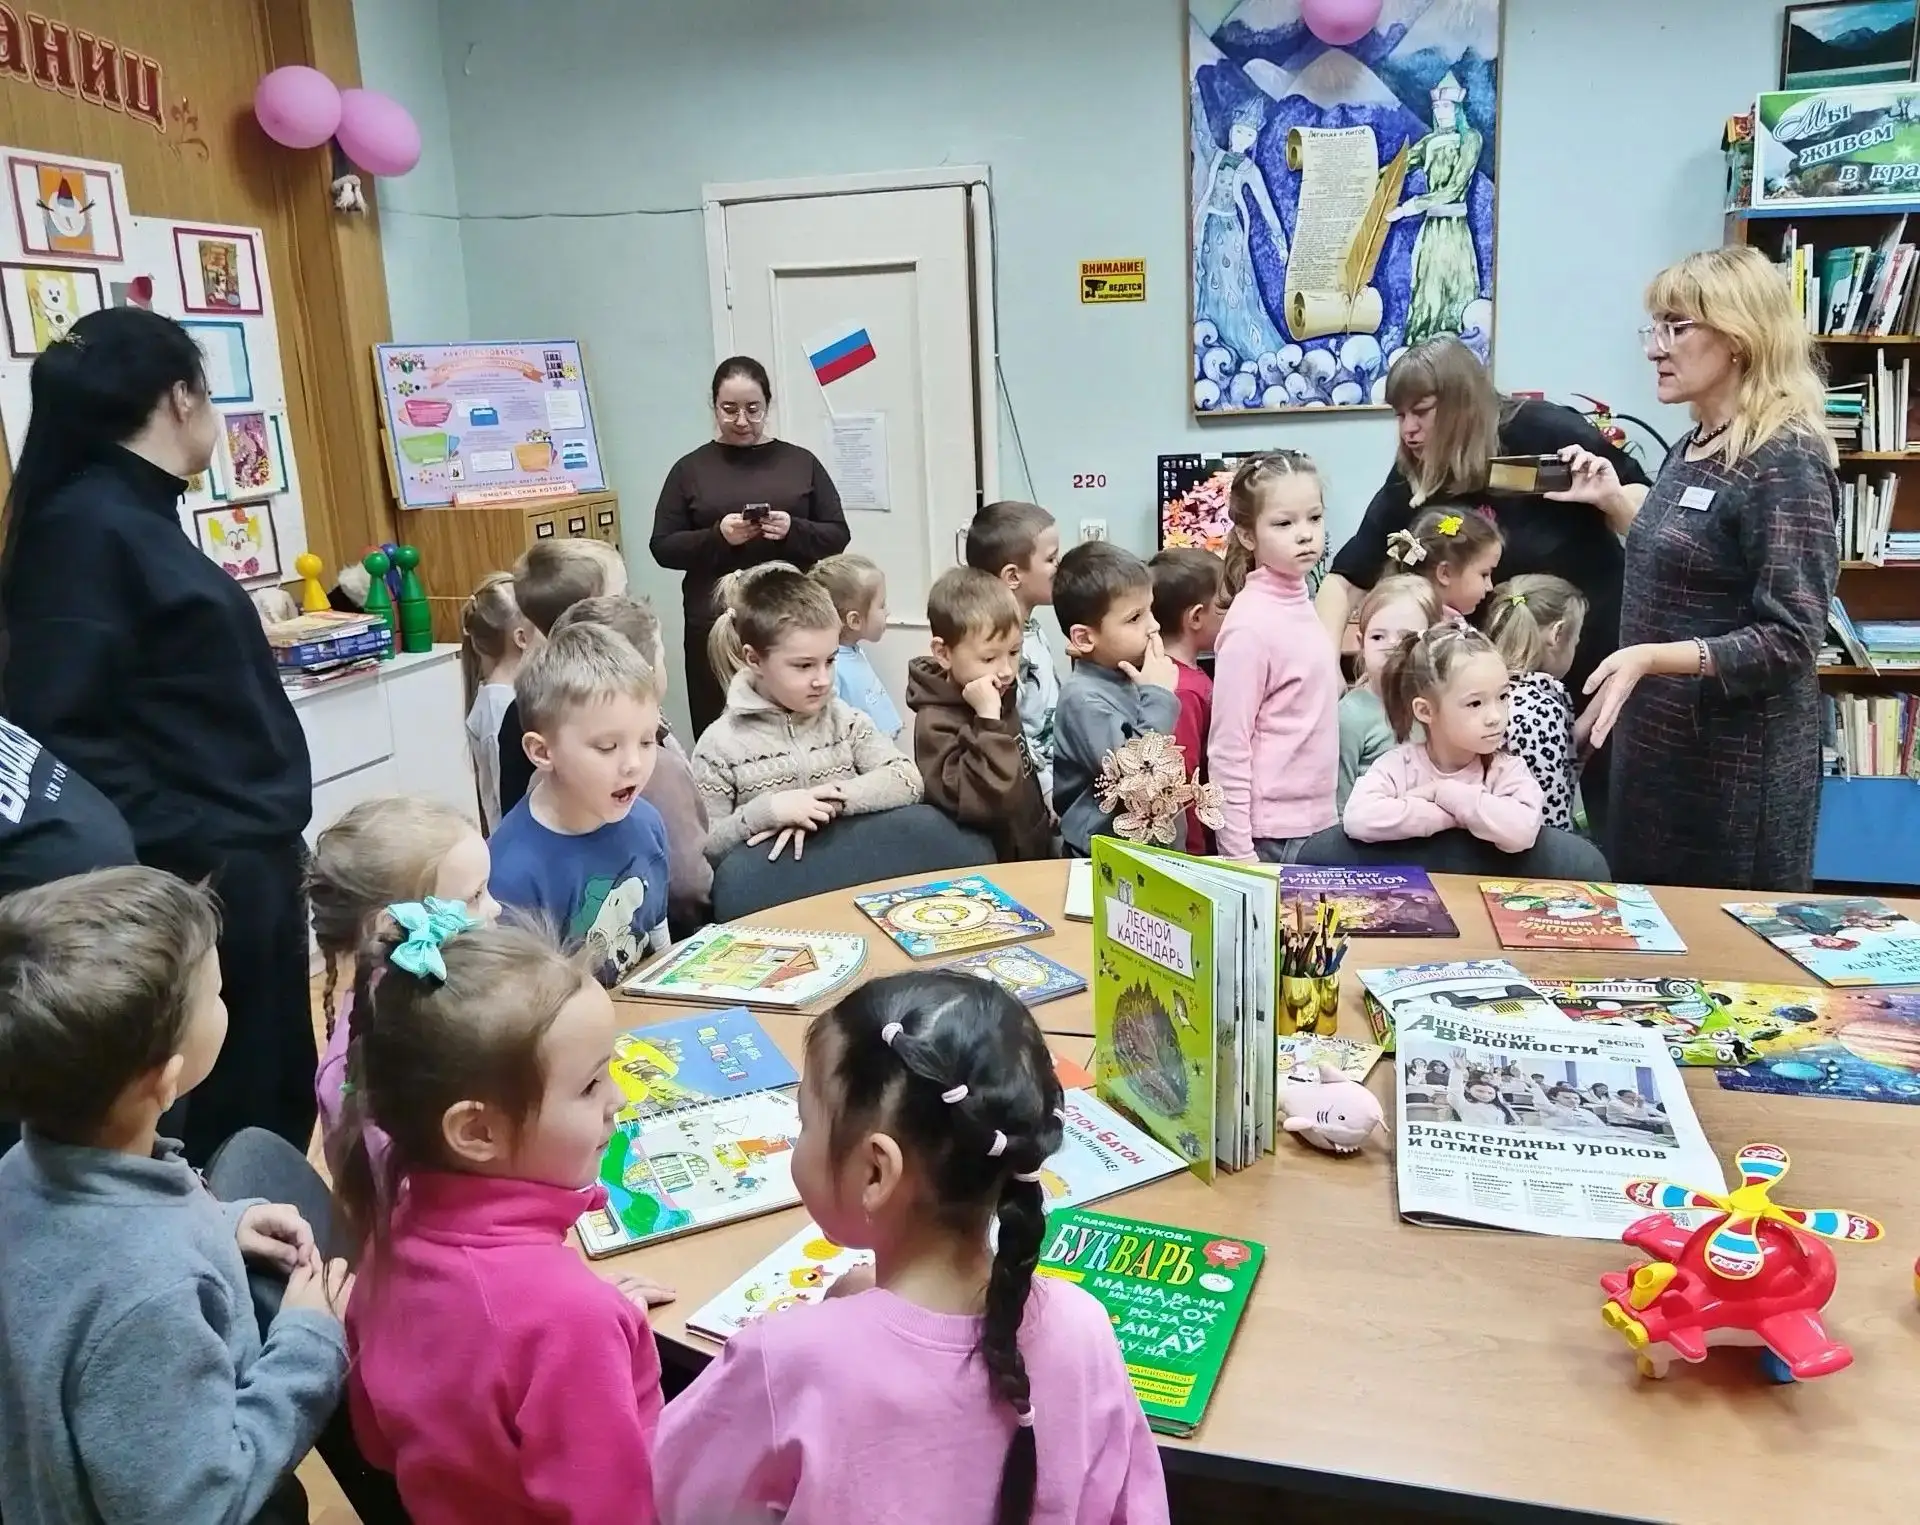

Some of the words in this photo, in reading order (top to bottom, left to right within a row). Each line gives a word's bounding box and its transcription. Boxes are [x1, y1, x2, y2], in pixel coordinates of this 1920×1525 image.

[1773, 99, 1851, 141] Мы
[1799, 122, 1895, 166] живем
[1839, 166, 1858, 181] в
[1870, 163, 1920, 184] кра
[1082, 261, 1144, 274] ВНИМАНИЕ!
[1108, 283, 1142, 292] ВЕДЕТСЯ
[1073, 474, 1107, 488] 220
[44, 781, 62, 802] NEW
[1126, 909, 1172, 944] ЛЕСНОЙ
[1516, 919, 1631, 937] БУКАШКИ
[1117, 922, 1184, 969] КАЛЕНДАРЬ
[1575, 984, 1653, 993] ШАШКИ
[1583, 999, 1592, 1007] 6
[1404, 1014, 1536, 1043] АНГАРСКИЕ
[1434, 1028, 1599, 1056] ВЕДОМОСТИ
[1065, 1104, 1099, 1132] СЛОН
[1096, 1131, 1145, 1165] БАТОН
[1407, 1124, 1566, 1152] Властелины
[1572, 1143, 1667, 1160] уроков
[1064, 1125, 1121, 1172] ЛИКЛИНИКЕ!
[1407, 1137, 1423, 1147] и
[1430, 1140, 1539, 1161] отметок
[1072, 1214, 1133, 1232] Надежда
[1135, 1225, 1193, 1243] ЖУКОВА
[1041, 1223, 1195, 1286] БУКВАРЬ
[1092, 1276, 1167, 1299] МА-МА
[1171, 1293, 1226, 1311] РА-МА
[1161, 1296, 1184, 1311] УС
[1128, 1307, 1180, 1326] РО-ЗА
[1182, 1308, 1217, 1324] ОХ
[1119, 1321, 1160, 1338] АМ
[1178, 1325, 1206, 1340] СА
[1158, 1334, 1206, 1353] АУ
[1127, 1366, 1192, 1382] АДИЦИОННОЙ
